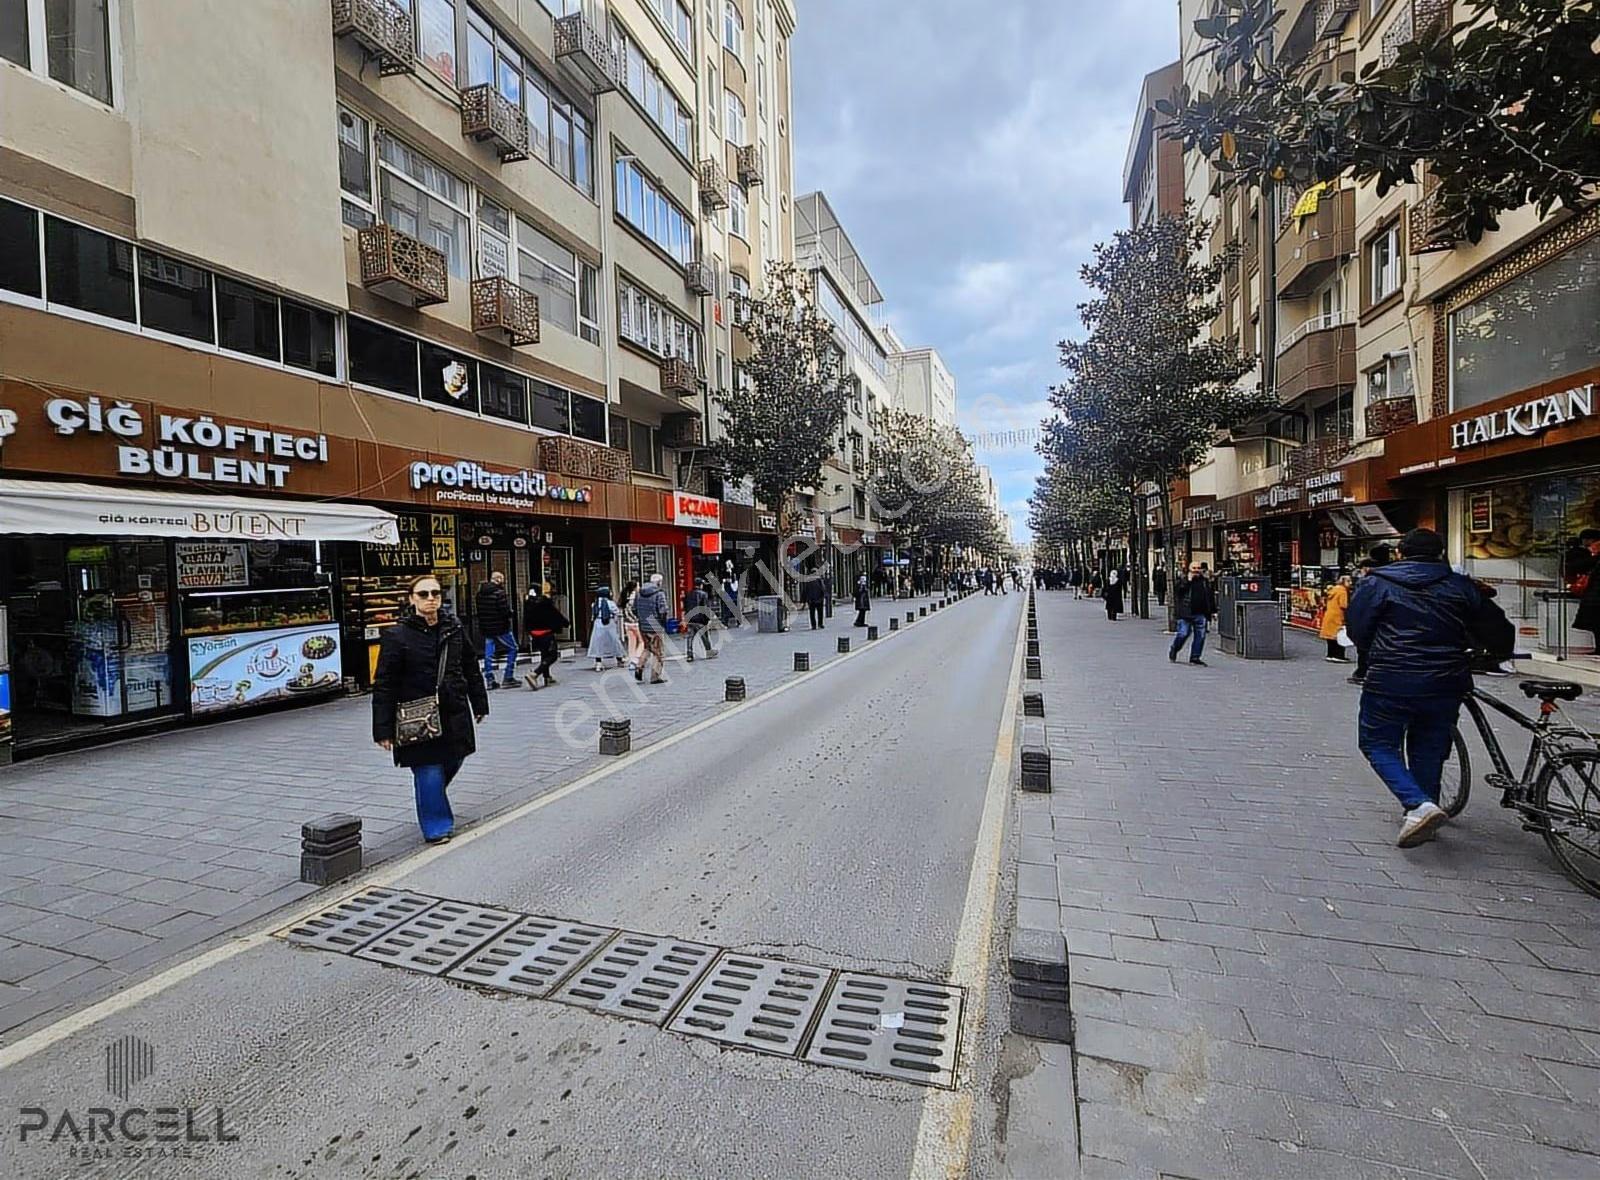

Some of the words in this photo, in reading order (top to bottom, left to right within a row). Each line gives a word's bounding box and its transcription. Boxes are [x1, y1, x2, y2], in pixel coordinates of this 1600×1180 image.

[46, 395, 144, 436] ÇİĞ
[160, 415, 329, 463] KÖFTECİ
[1451, 384, 1594, 449] HALKTAN
[118, 444, 291, 488] BÜLENT
[190, 510, 306, 539] BÜLENT
[378, 552, 431, 567] WAFFLE
